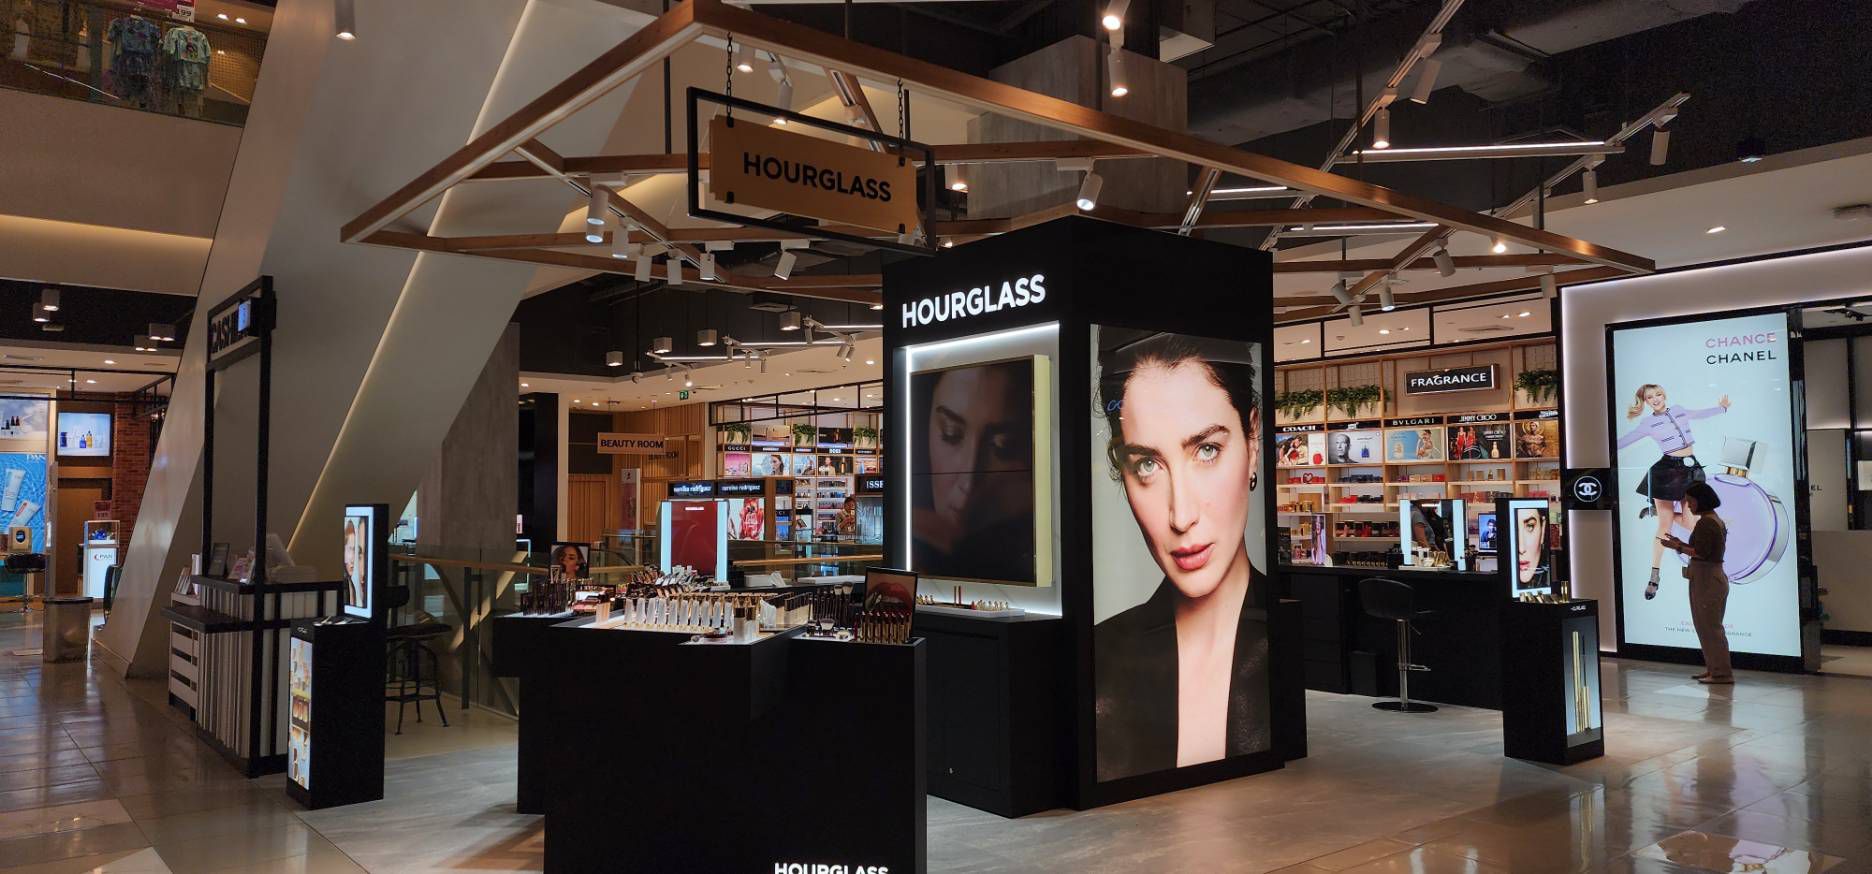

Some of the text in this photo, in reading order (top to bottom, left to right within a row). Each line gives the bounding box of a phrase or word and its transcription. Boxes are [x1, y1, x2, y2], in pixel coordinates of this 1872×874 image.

[743, 151, 892, 203] HOURGLASS
[902, 274, 1047, 329] HOURGLASS
[1705, 332, 1777, 348] CHANCE
[1706, 349, 1777, 365] CHANEL
[1410, 372, 1488, 388] FRAGRANCE
[1392, 417, 1435, 426] BVLGARI
[600, 439, 664, 449] BEAUTY ROOM
